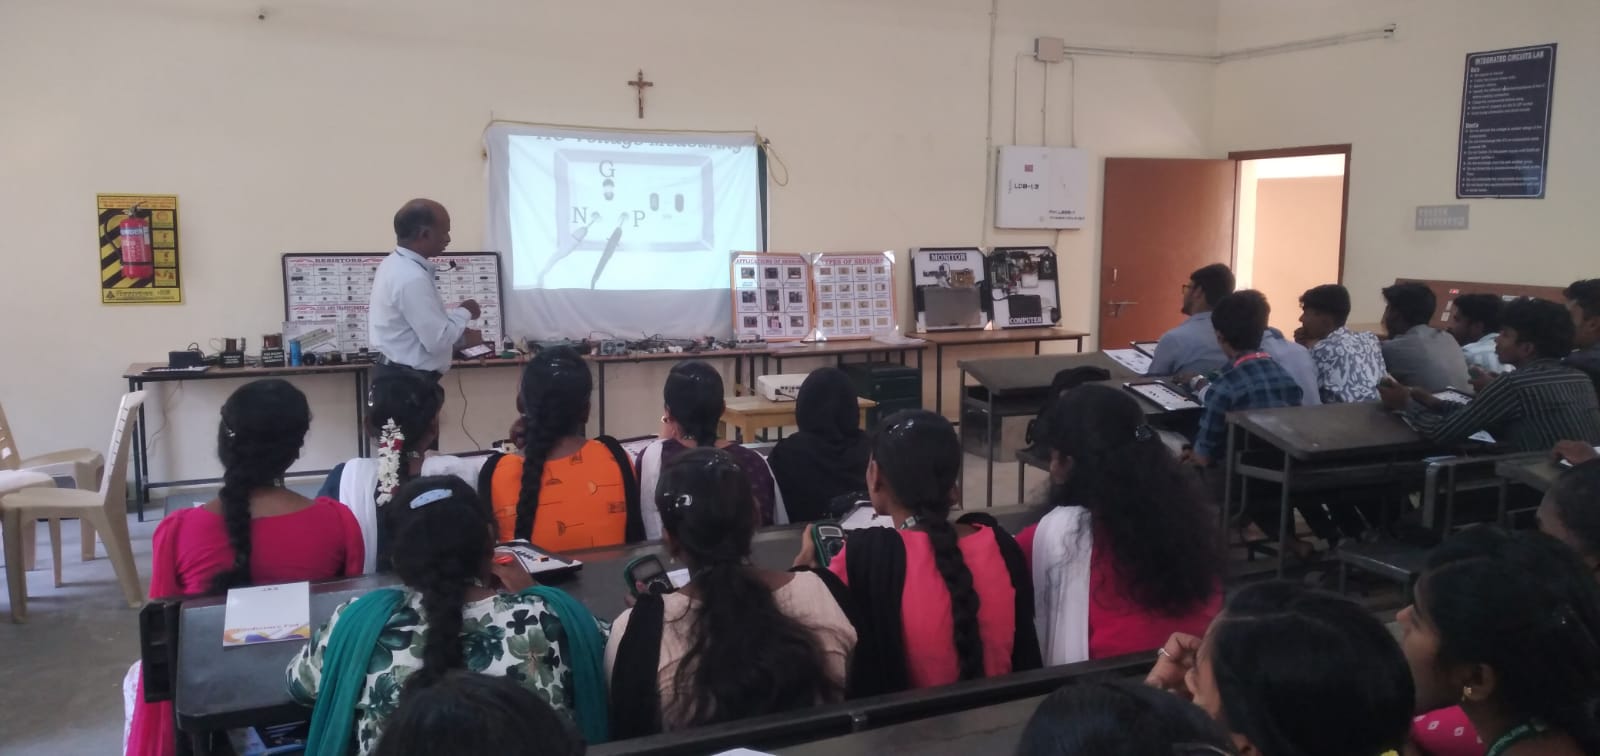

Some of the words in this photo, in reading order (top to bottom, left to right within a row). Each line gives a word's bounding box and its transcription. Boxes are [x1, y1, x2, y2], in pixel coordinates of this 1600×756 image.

[1532, 50, 1545, 59] LAB
[599, 160, 616, 178] G
[571, 206, 587, 224] N
[632, 210, 646, 227] P
[931, 253, 967, 261] MONITOR
[1009, 316, 1043, 324] COMPUTER
